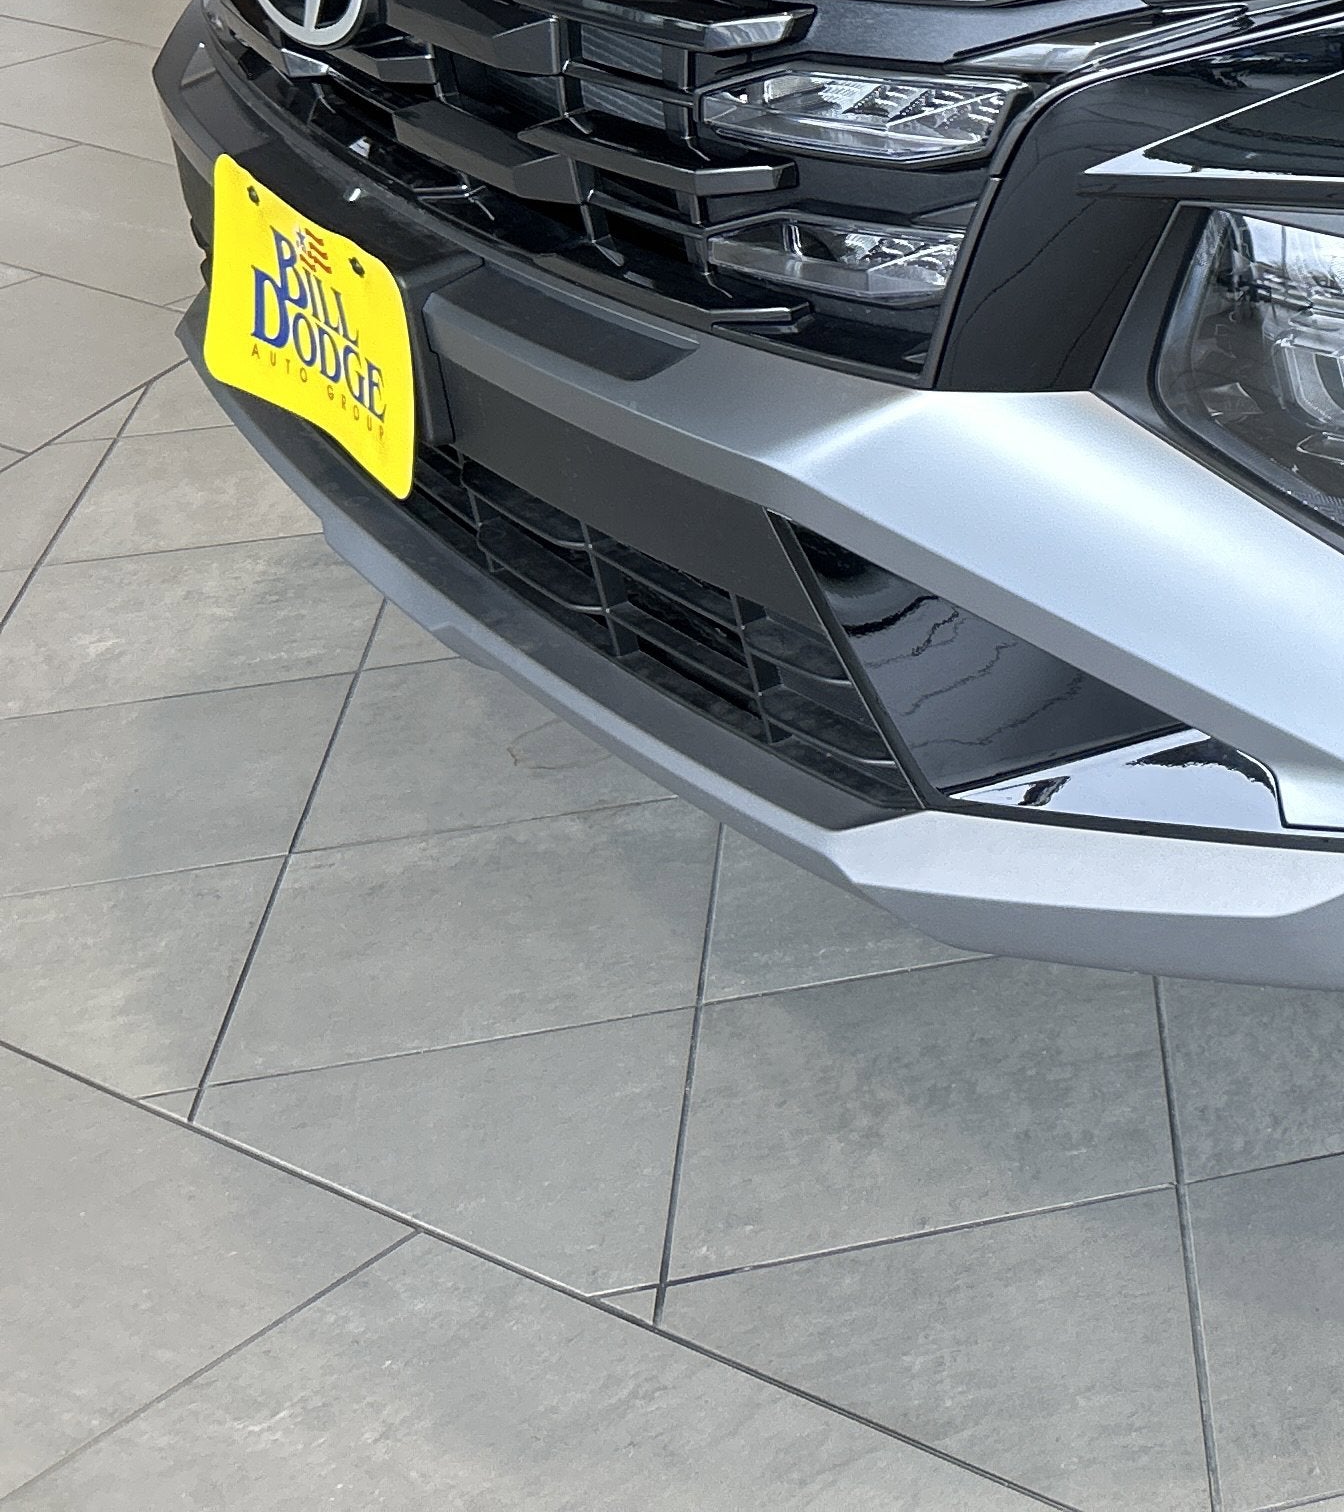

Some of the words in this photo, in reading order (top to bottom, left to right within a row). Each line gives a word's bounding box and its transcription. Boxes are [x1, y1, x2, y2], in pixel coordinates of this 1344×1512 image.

[250, 263, 388, 425] DODGE
[269, 224, 361, 347] BILL
[250, 342, 308, 384] AUTO
[326, 383, 388, 439] GROUP
